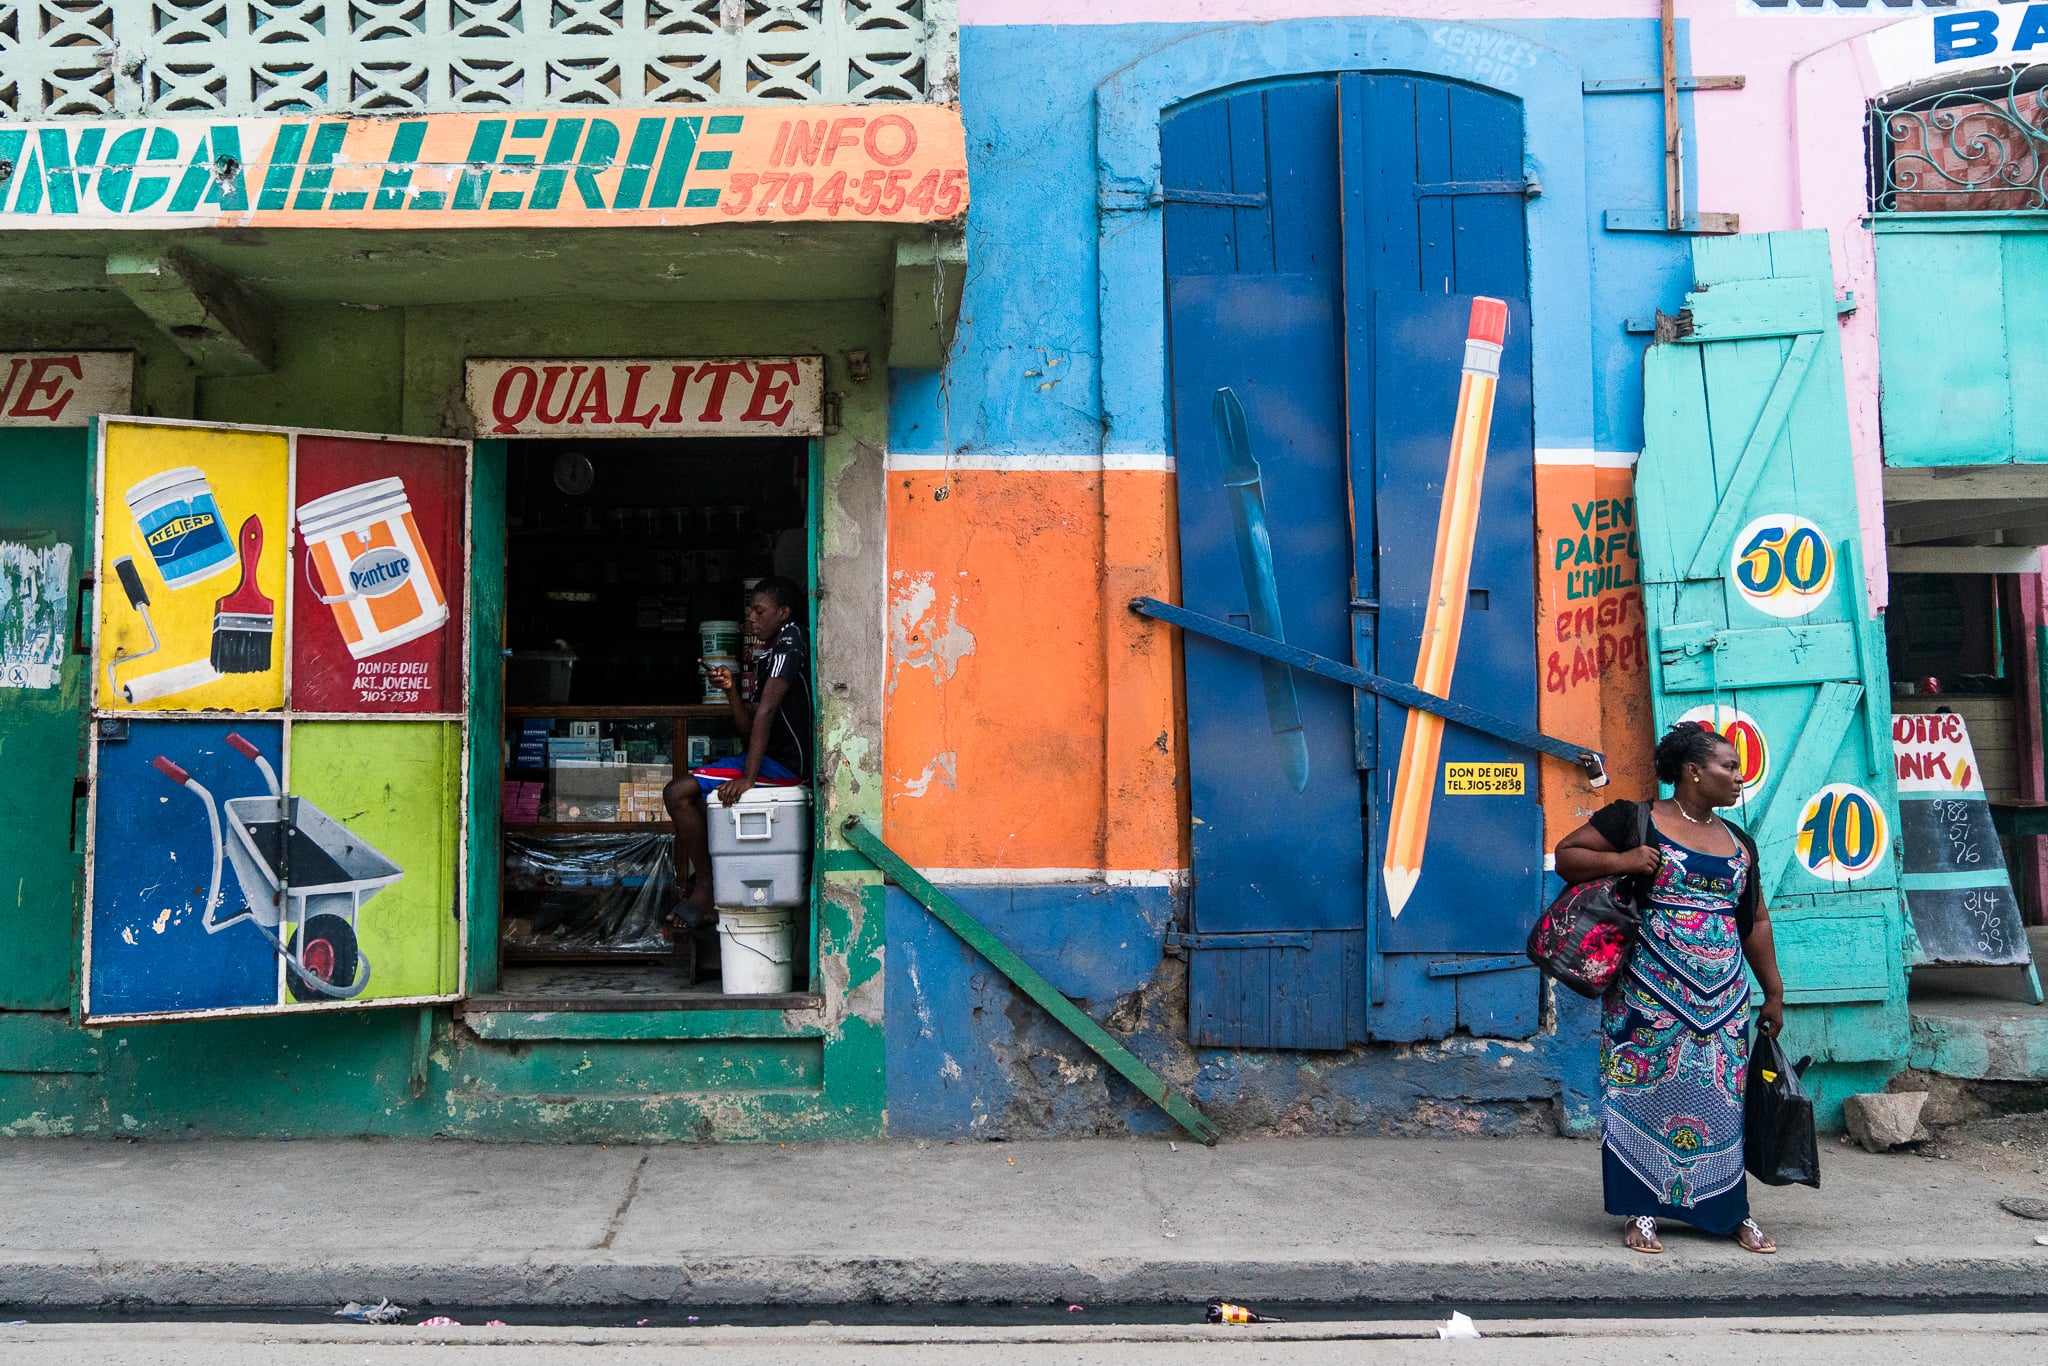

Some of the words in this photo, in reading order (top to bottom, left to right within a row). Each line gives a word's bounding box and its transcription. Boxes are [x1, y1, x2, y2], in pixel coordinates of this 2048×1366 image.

[770, 114, 918, 168] INFO
[721, 169, 966, 216] 3704:5545
[492, 361, 801, 435] QUALITE
[1737, 527, 1829, 593] 50
[357, 662, 381, 674] DON
[382, 662, 398, 674] DE
[399, 662, 428, 674] DIEU
[1449, 767, 1474, 778] DON
[1478, 767, 1491, 778] DE
[1494, 767, 1518, 778] DIEU
[1697, 720, 1762, 783] 0
[1894, 752, 1952, 780] NK
[1803, 791, 1876, 868] 10
[1954, 841, 1980, 864] 76
[1964, 891, 2000, 911] 314
